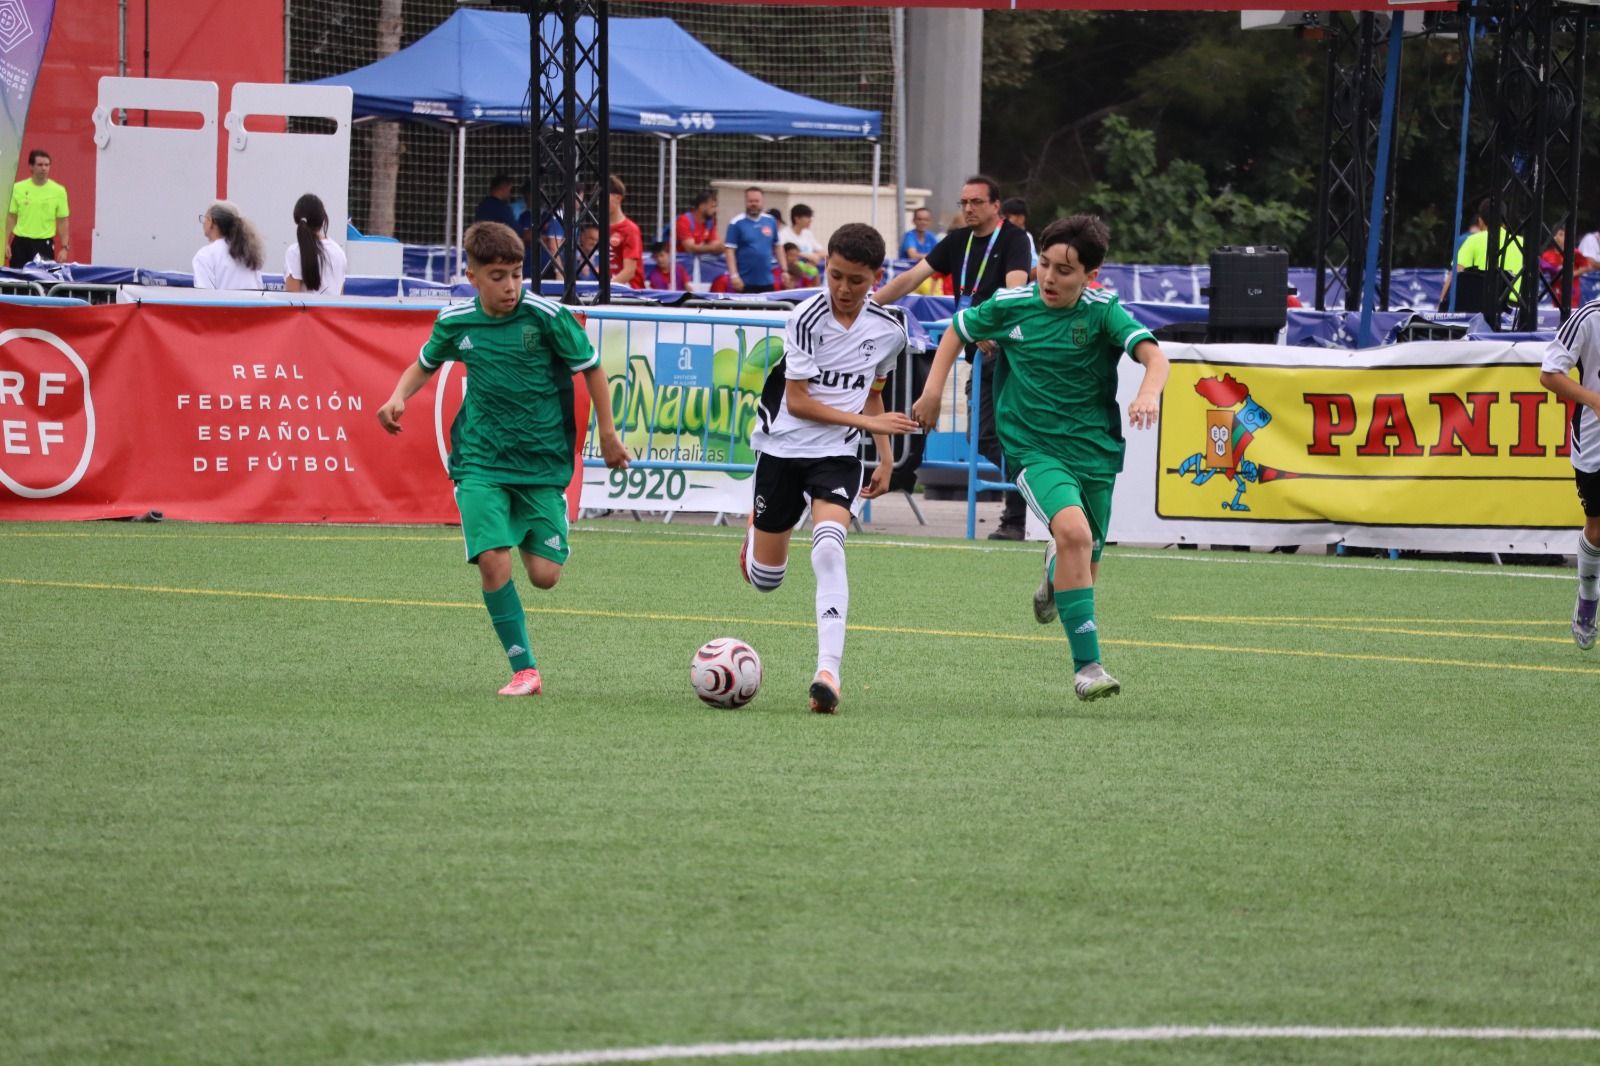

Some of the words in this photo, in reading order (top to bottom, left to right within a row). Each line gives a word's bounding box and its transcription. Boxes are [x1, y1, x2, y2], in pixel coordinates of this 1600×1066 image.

[232, 364, 304, 380] REAL
[0, 370, 67, 407] RF
[177, 390, 362, 411] FEDERACIÓN
[2, 419, 64, 456] EF
[198, 421, 347, 441] ESPAÑOLA
[193, 457, 229, 472] DE
[248, 451, 355, 472] FÚTBOL
[608, 467, 686, 501] 9920
